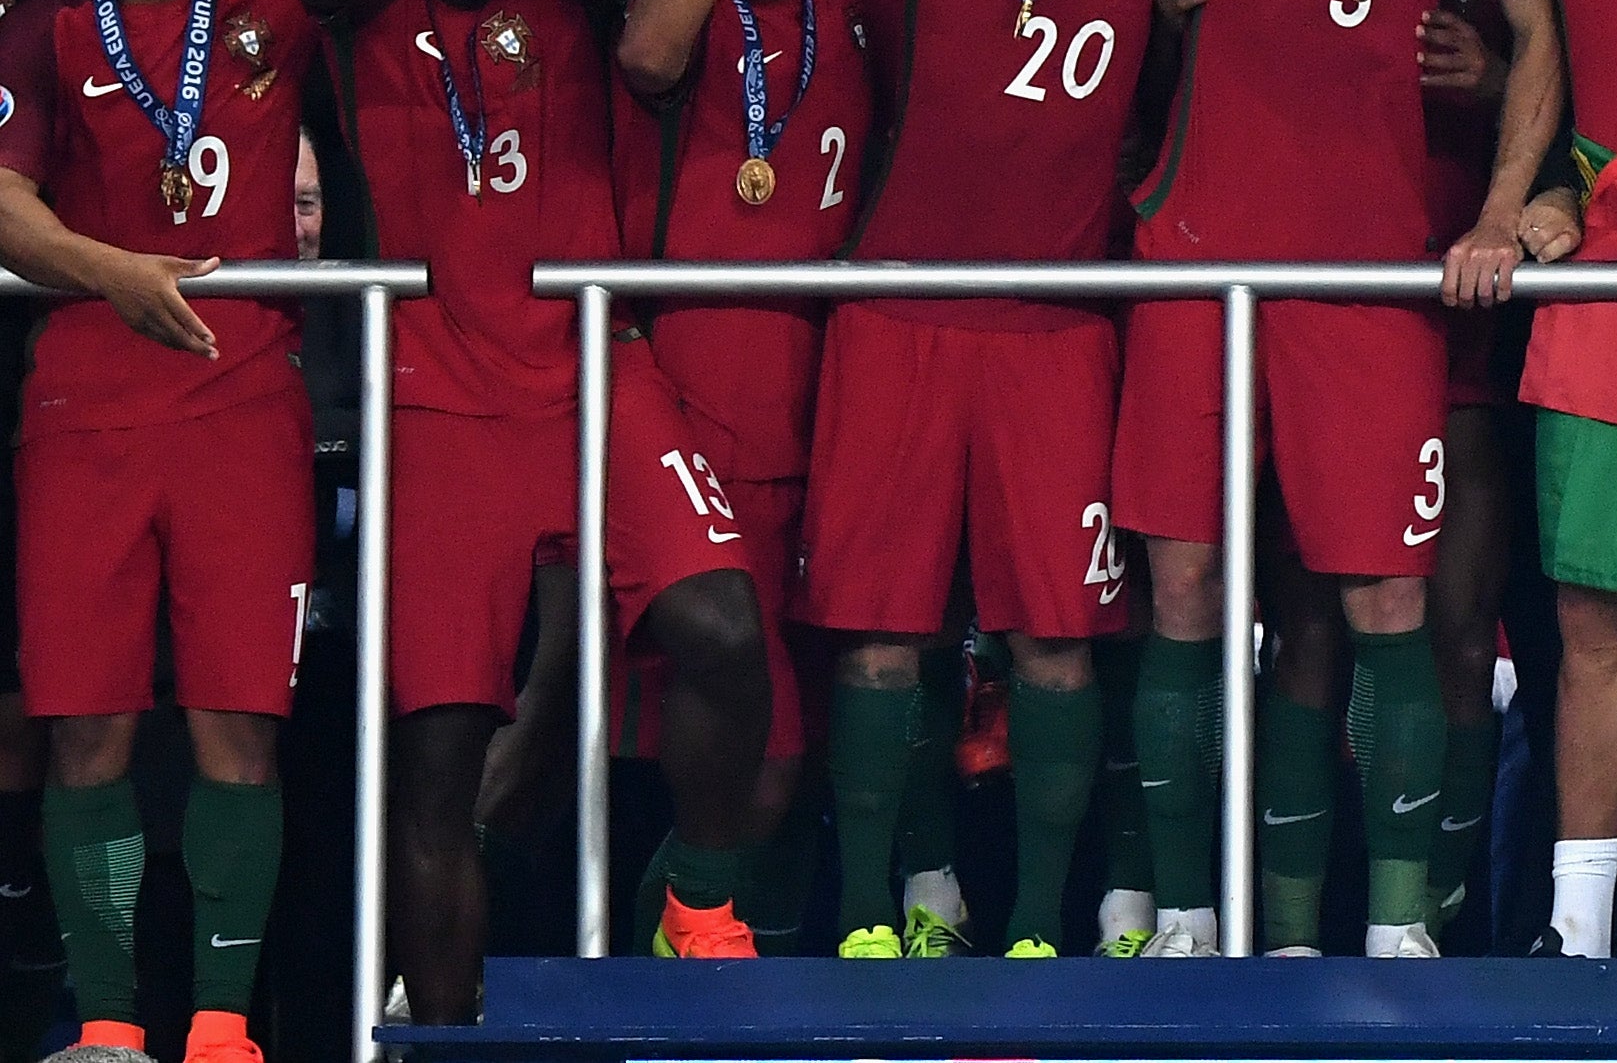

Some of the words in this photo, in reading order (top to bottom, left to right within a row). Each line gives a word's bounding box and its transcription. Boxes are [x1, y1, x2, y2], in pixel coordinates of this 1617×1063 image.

[98, 1, 123, 55] EURO
[1004, 16, 1115, 102] 20
[116, 54, 154, 108] UEFA
[182, 47, 206, 100] 2016
[819, 127, 846, 210] 2
[661, 449, 736, 520] 13
[1414, 438, 1445, 520] 3
[290, 582, 309, 664] 1
